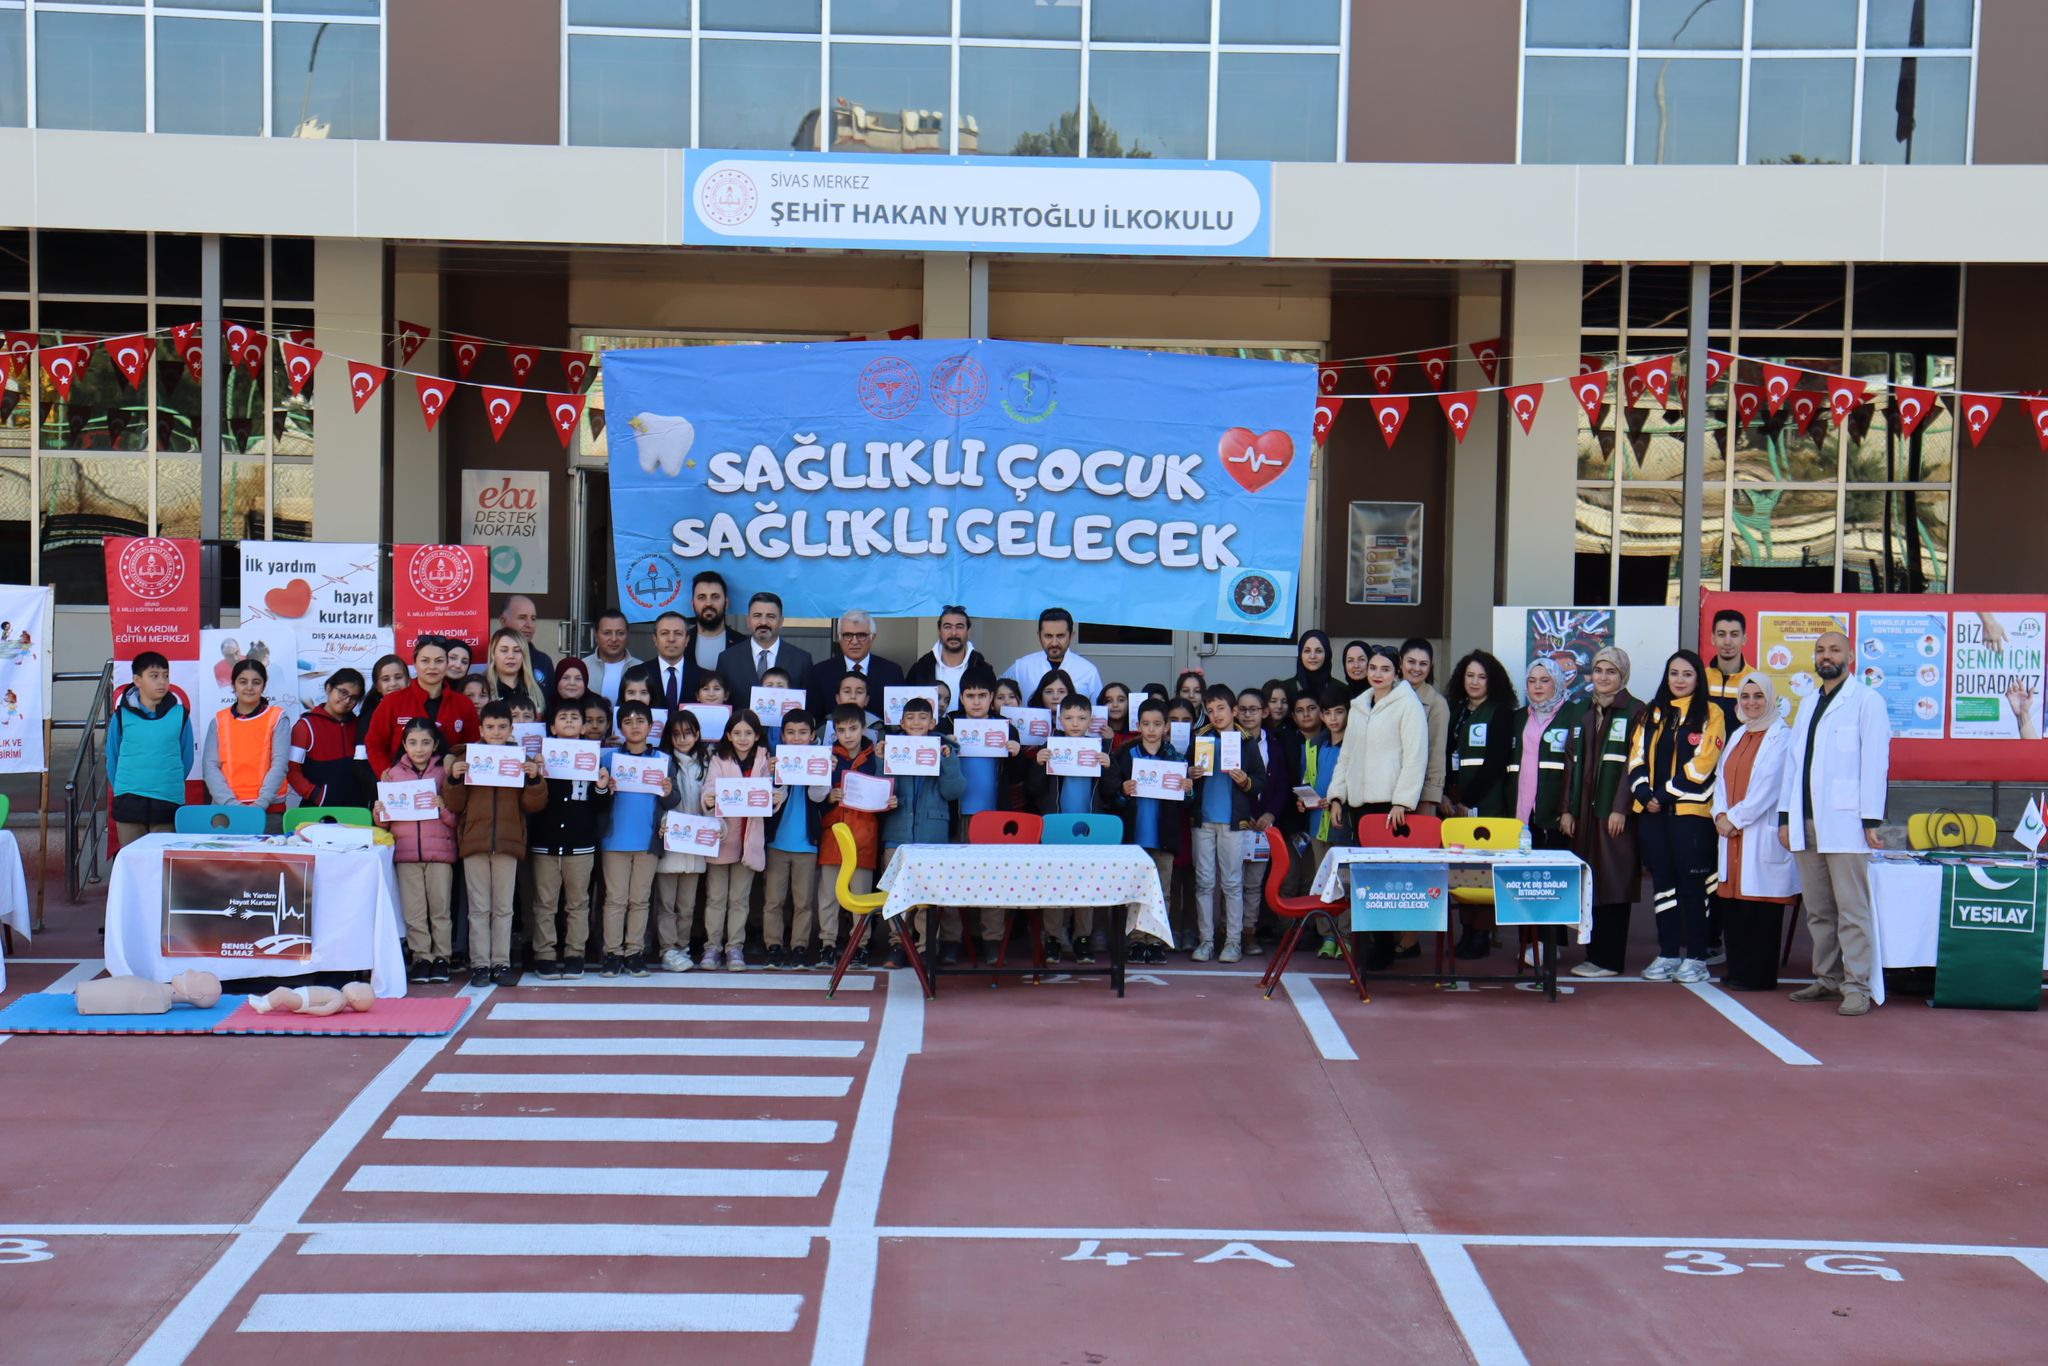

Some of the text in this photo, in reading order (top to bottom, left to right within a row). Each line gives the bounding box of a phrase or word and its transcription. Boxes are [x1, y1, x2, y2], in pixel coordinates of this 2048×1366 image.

[771, 172, 870, 190] SİVAS MERKEZ
[771, 198, 1234, 231] ŞEHİT HAKAN YURTOĞLU İLKOKULU
[707, 432, 1206, 502] SAĞLIKLI ÇOCUK
[478, 477, 538, 510] eba
[475, 510, 537, 524] DESTEK
[472, 524, 537, 537] NOKTASI
[671, 500, 1240, 571] SAĞLIKLI GELECEK
[245, 554, 316, 576] İlk yardım
[334, 590, 374, 607] hayat
[319, 610, 374, 625] kurtarır
[126, 624, 178, 633] İLK YARDIM
[1957, 620, 1983, 644] BİZ
[115, 633, 190, 643] EĞİTİM MERKEZİ
[2010, 645, 2041, 673] İÇİN
[12, 738, 22, 747] VE
[1522, 881, 1532, 889] VE
[229, 898, 250, 907] Hayat
[1365, 901, 1430, 909] SAĞLIKLI GELECEK
[1368, 892, 1427, 902] SAĞLIKLI ÇOCUK
[1958, 905, 2029, 925] YEŞİLAY
[221, 942, 254, 950] SENSİZ
[221, 949, 254, 957] OLMAZ
[1060, 1239, 1296, 1268] 4-A
[1663, 1249, 1905, 1282] 3-G
